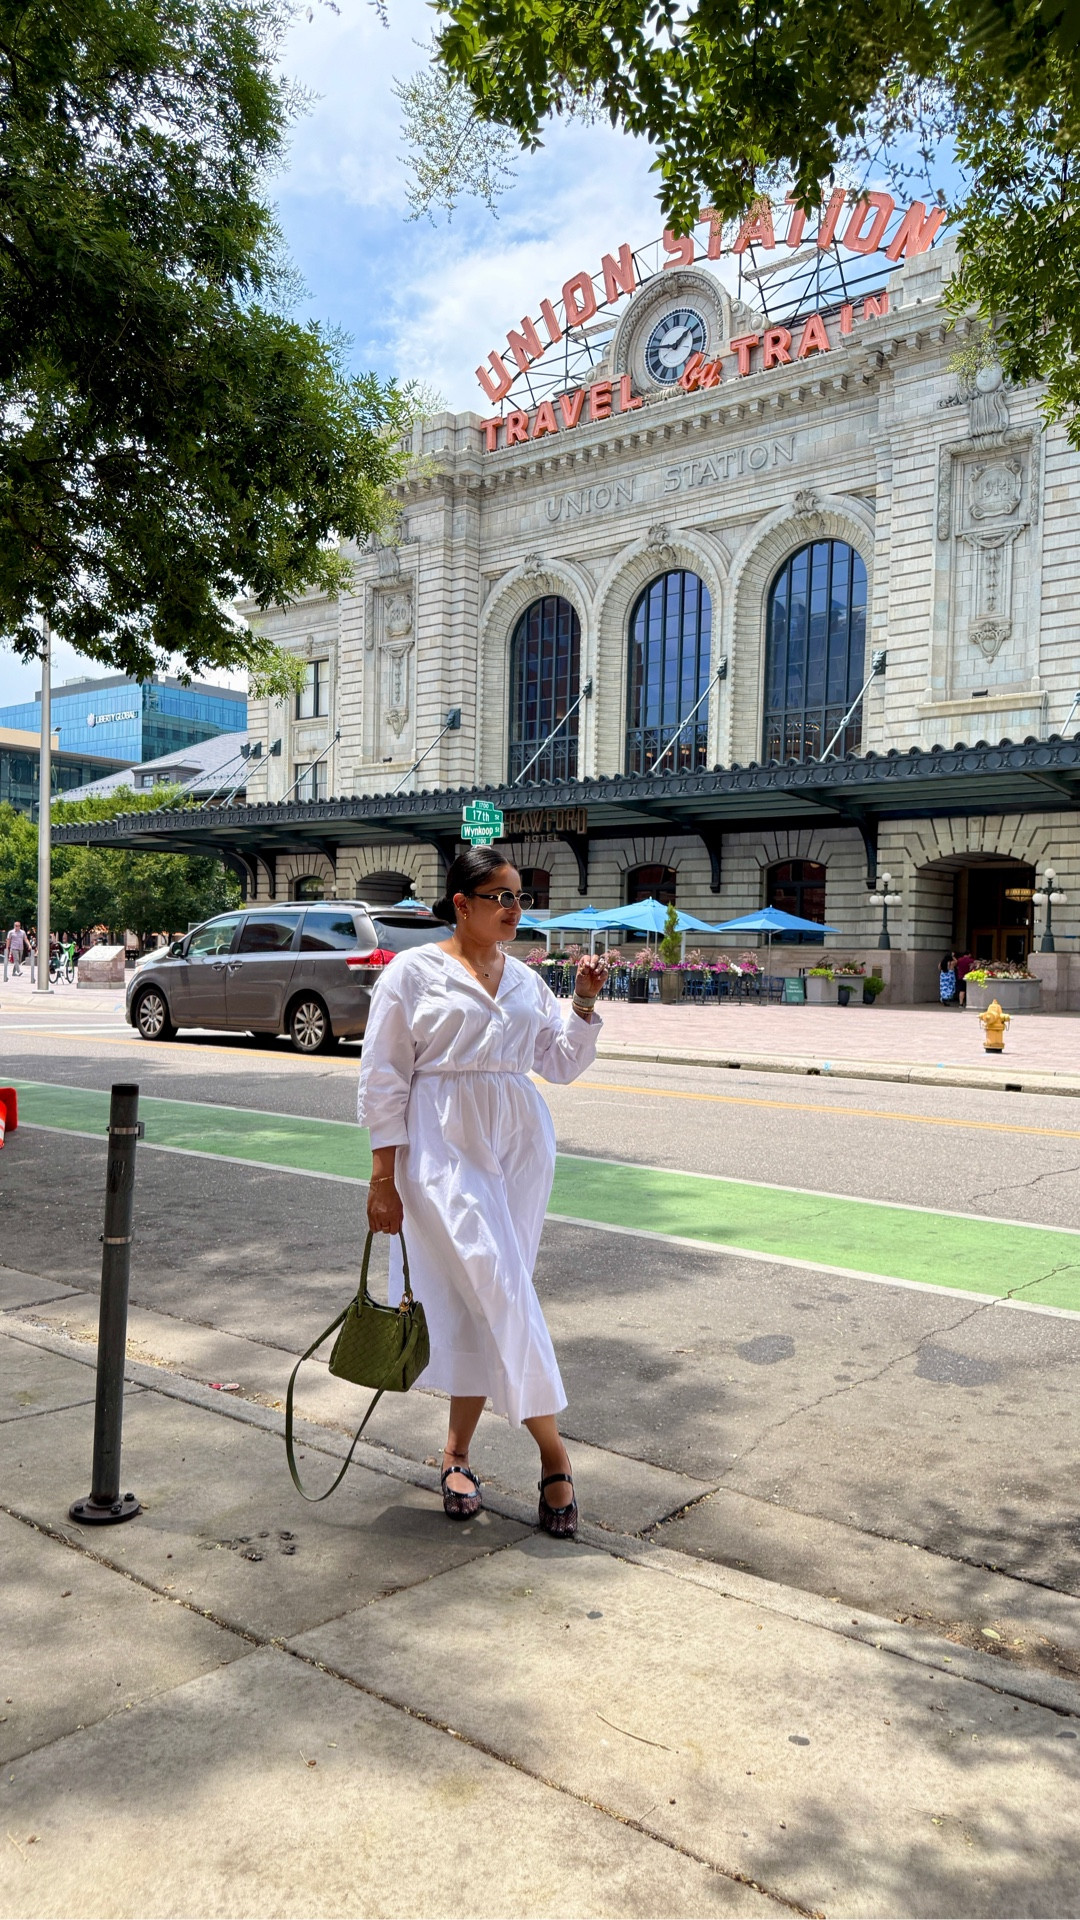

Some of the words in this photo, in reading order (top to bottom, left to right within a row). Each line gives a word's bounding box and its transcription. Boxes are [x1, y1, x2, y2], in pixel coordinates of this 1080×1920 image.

[475, 243, 637, 403] UNION
[663, 187, 947, 270] STATION
[480, 374, 643, 452] TRAVEL
[730, 291, 890, 376] TRAIN
[545, 478, 634, 522] UNION
[663, 436, 795, 494] STATION
[978, 477, 1011, 500] 1914
[473, 809, 490, 822] 17th
[505, 807, 588, 838] RAWFORD
[463, 826, 493, 837] Wynkoop
[524, 834, 560, 843] HOTEL
